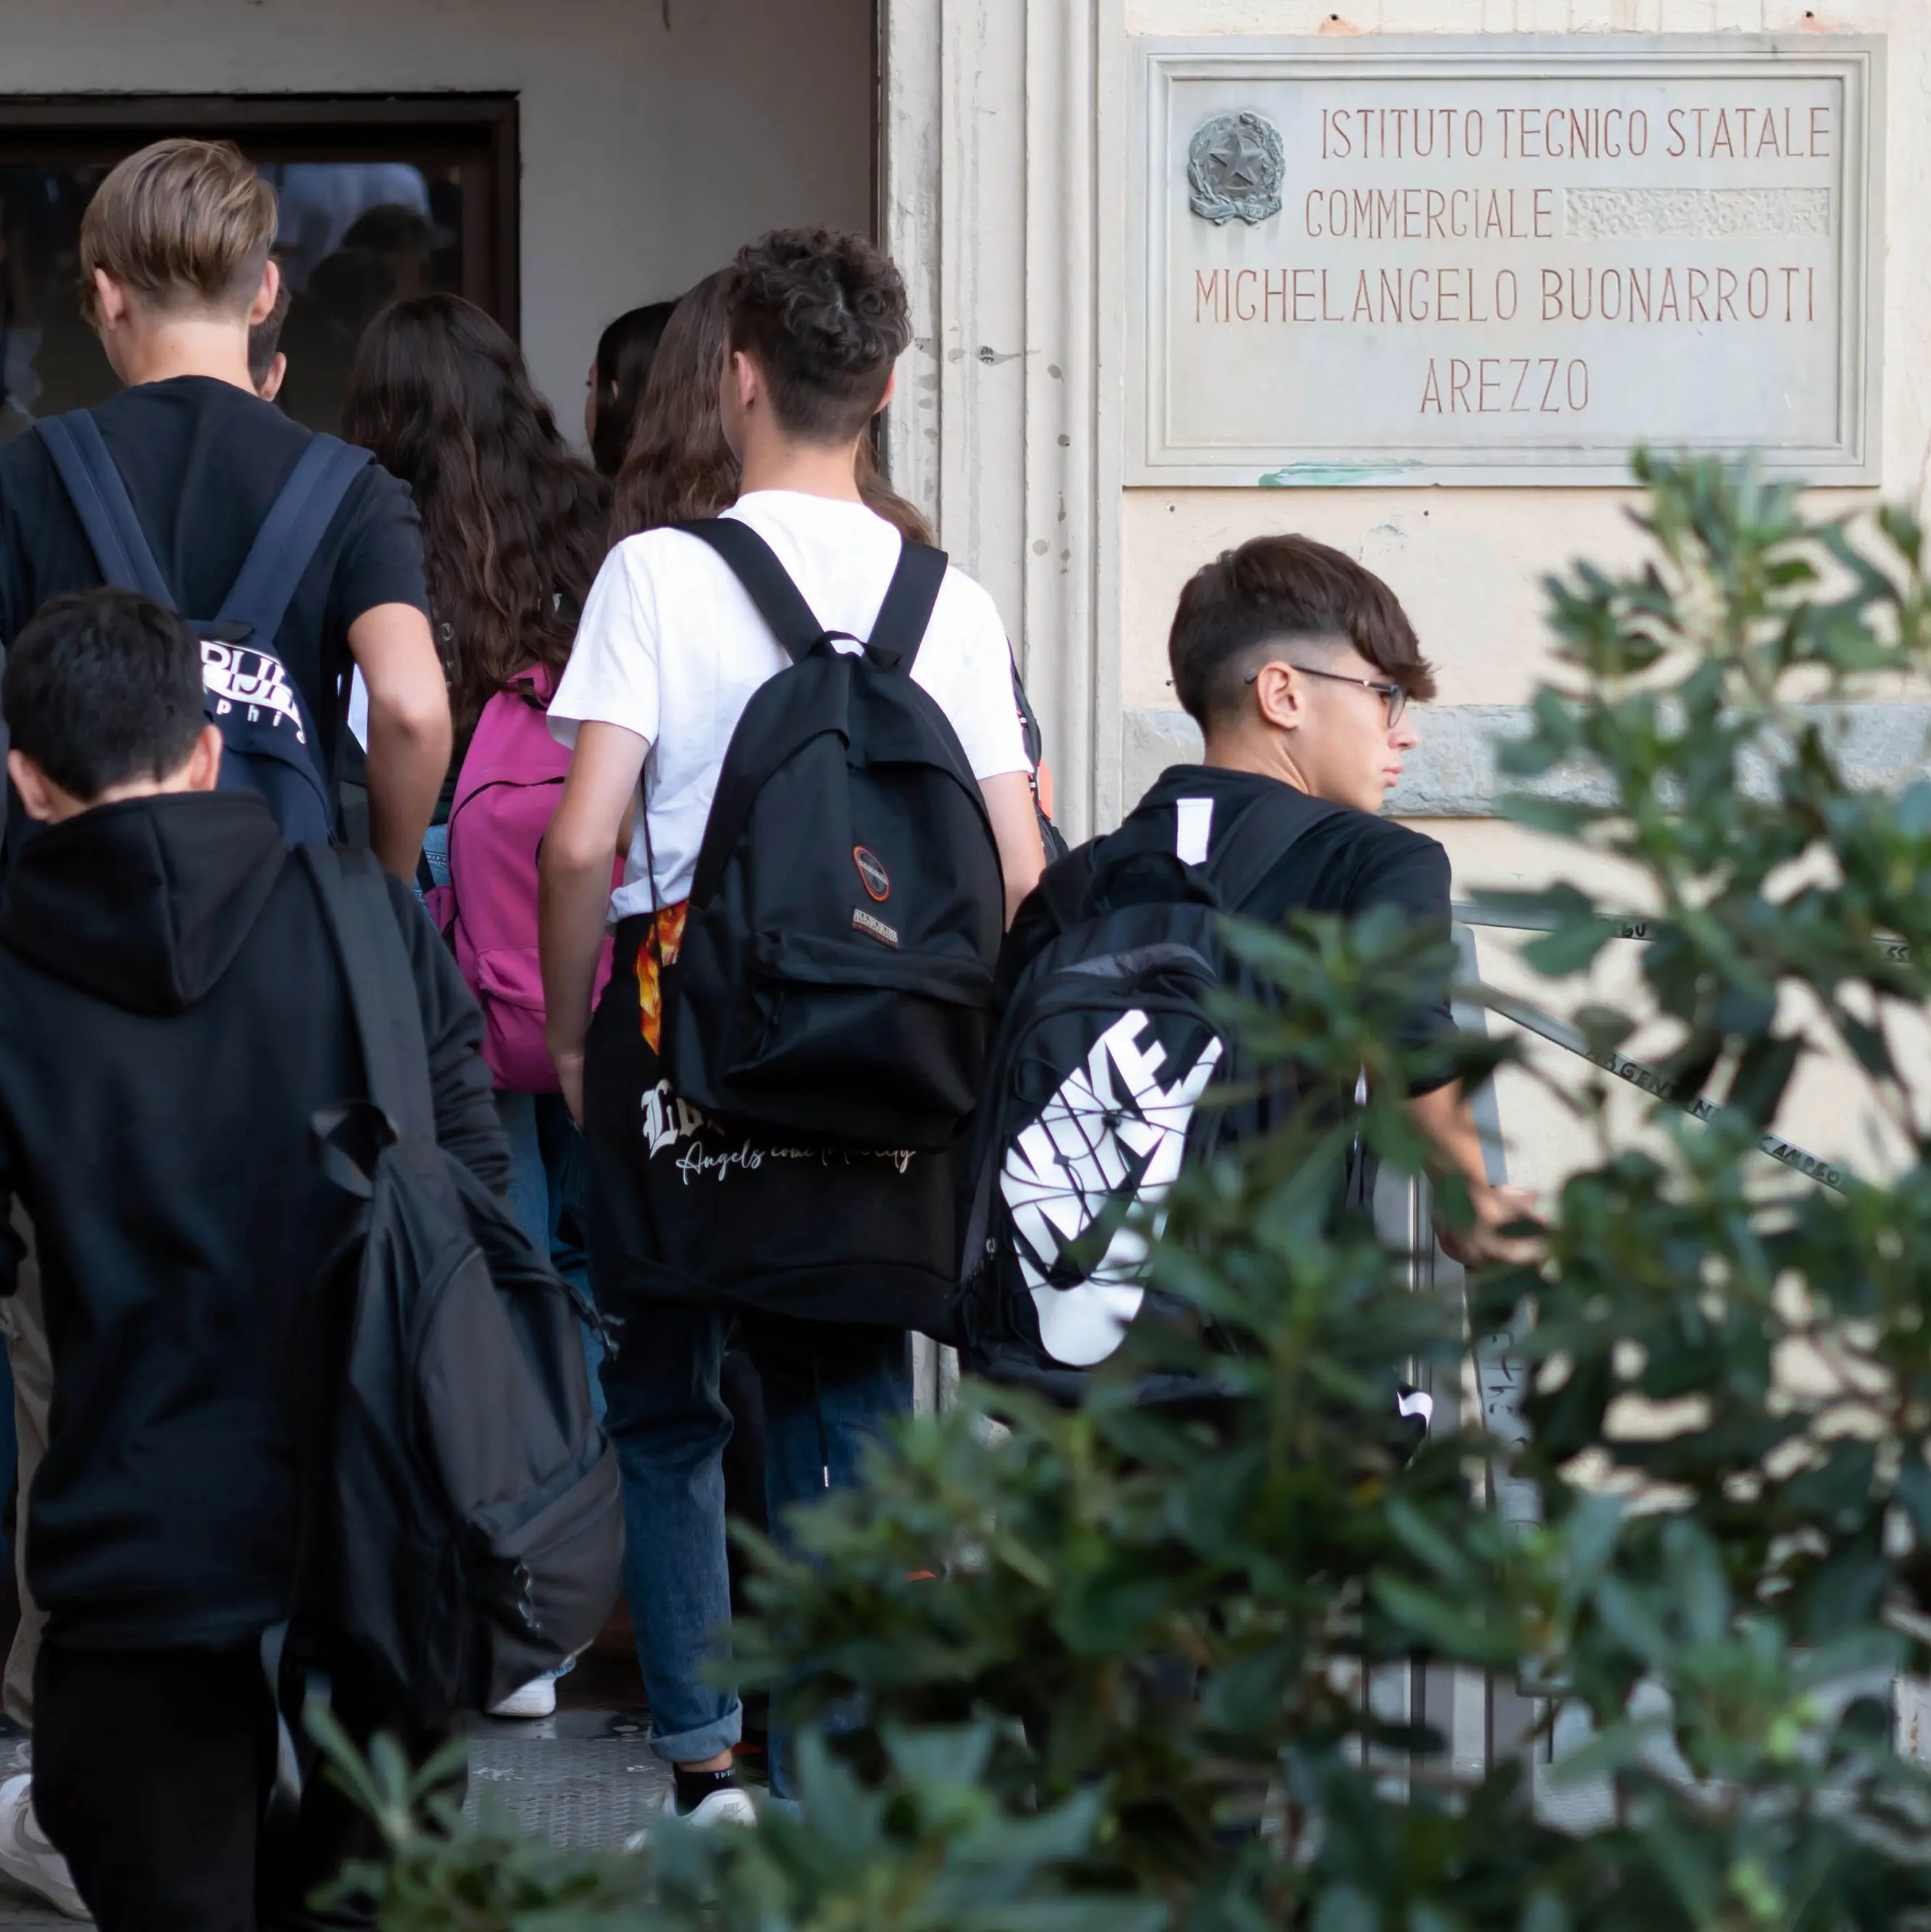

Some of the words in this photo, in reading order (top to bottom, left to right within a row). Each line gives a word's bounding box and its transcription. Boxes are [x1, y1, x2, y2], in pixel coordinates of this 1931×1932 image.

[1321, 108, 1484, 159] ISTITUTO
[1497, 107, 1648, 159] TECNICO
[1666, 107, 1830, 159] STATALE
[1305, 188, 1553, 239] COMMERCIALE
[1194, 267, 1518, 323] MICHELANGELO
[1540, 267, 1815, 323] BUONARROTI
[1419, 357, 1589, 414] AREZZO
[675, 1138, 766, 1186] Angels
